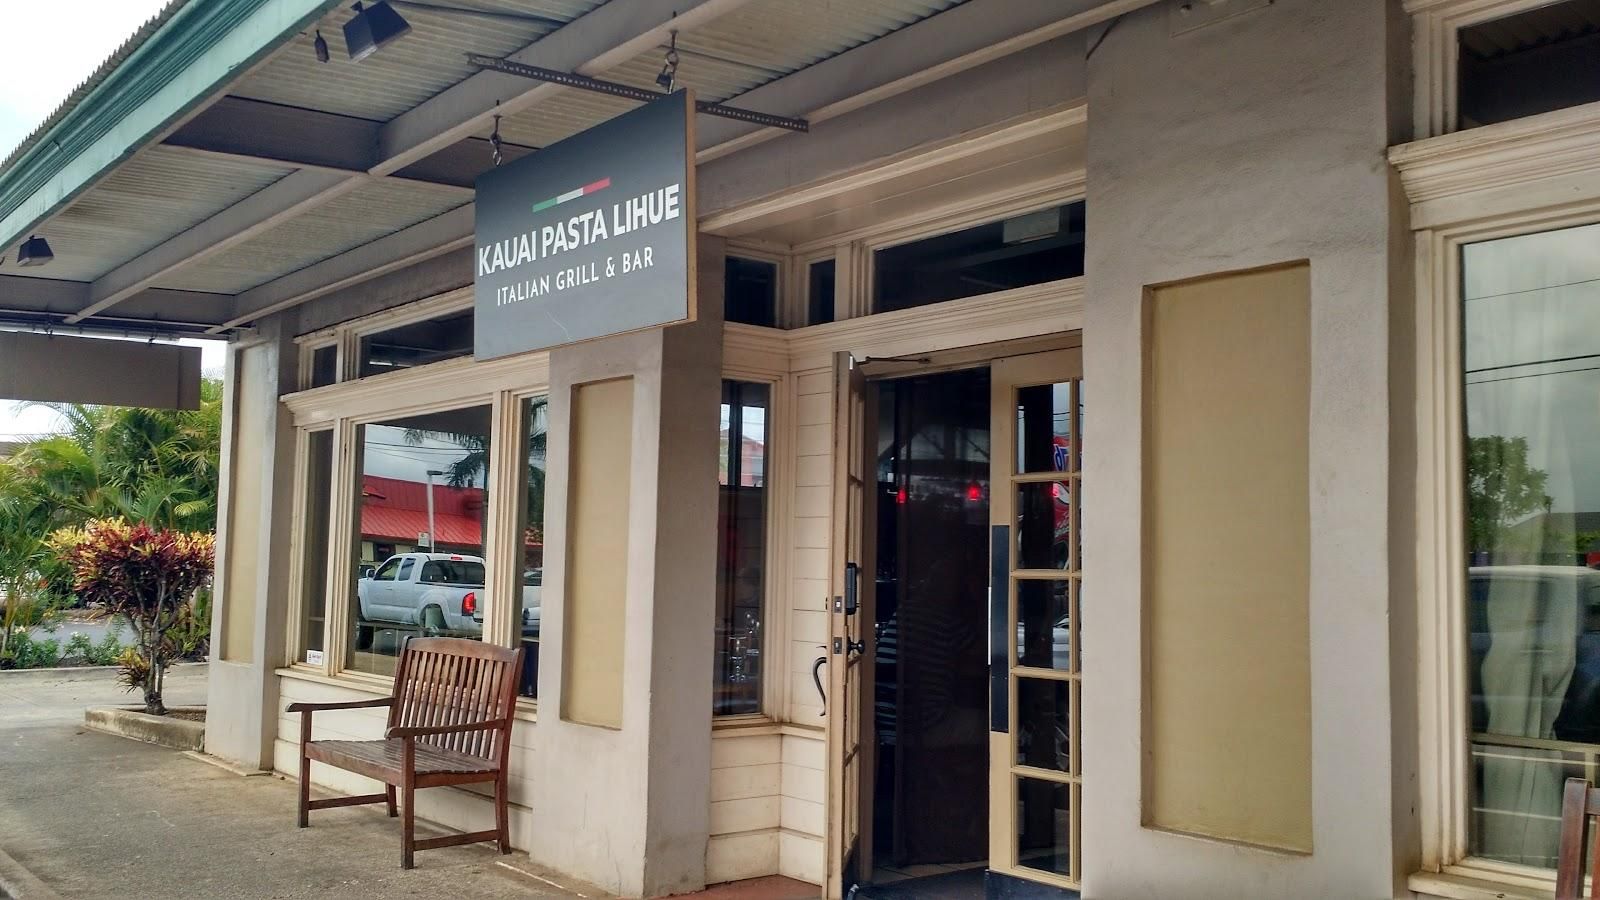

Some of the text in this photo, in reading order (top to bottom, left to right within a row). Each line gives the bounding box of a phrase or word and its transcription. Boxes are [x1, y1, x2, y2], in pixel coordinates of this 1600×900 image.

[478, 183, 680, 277] KAUAI PASTA LIHUE
[497, 246, 653, 306] ITALIAN GRILL & BAR
